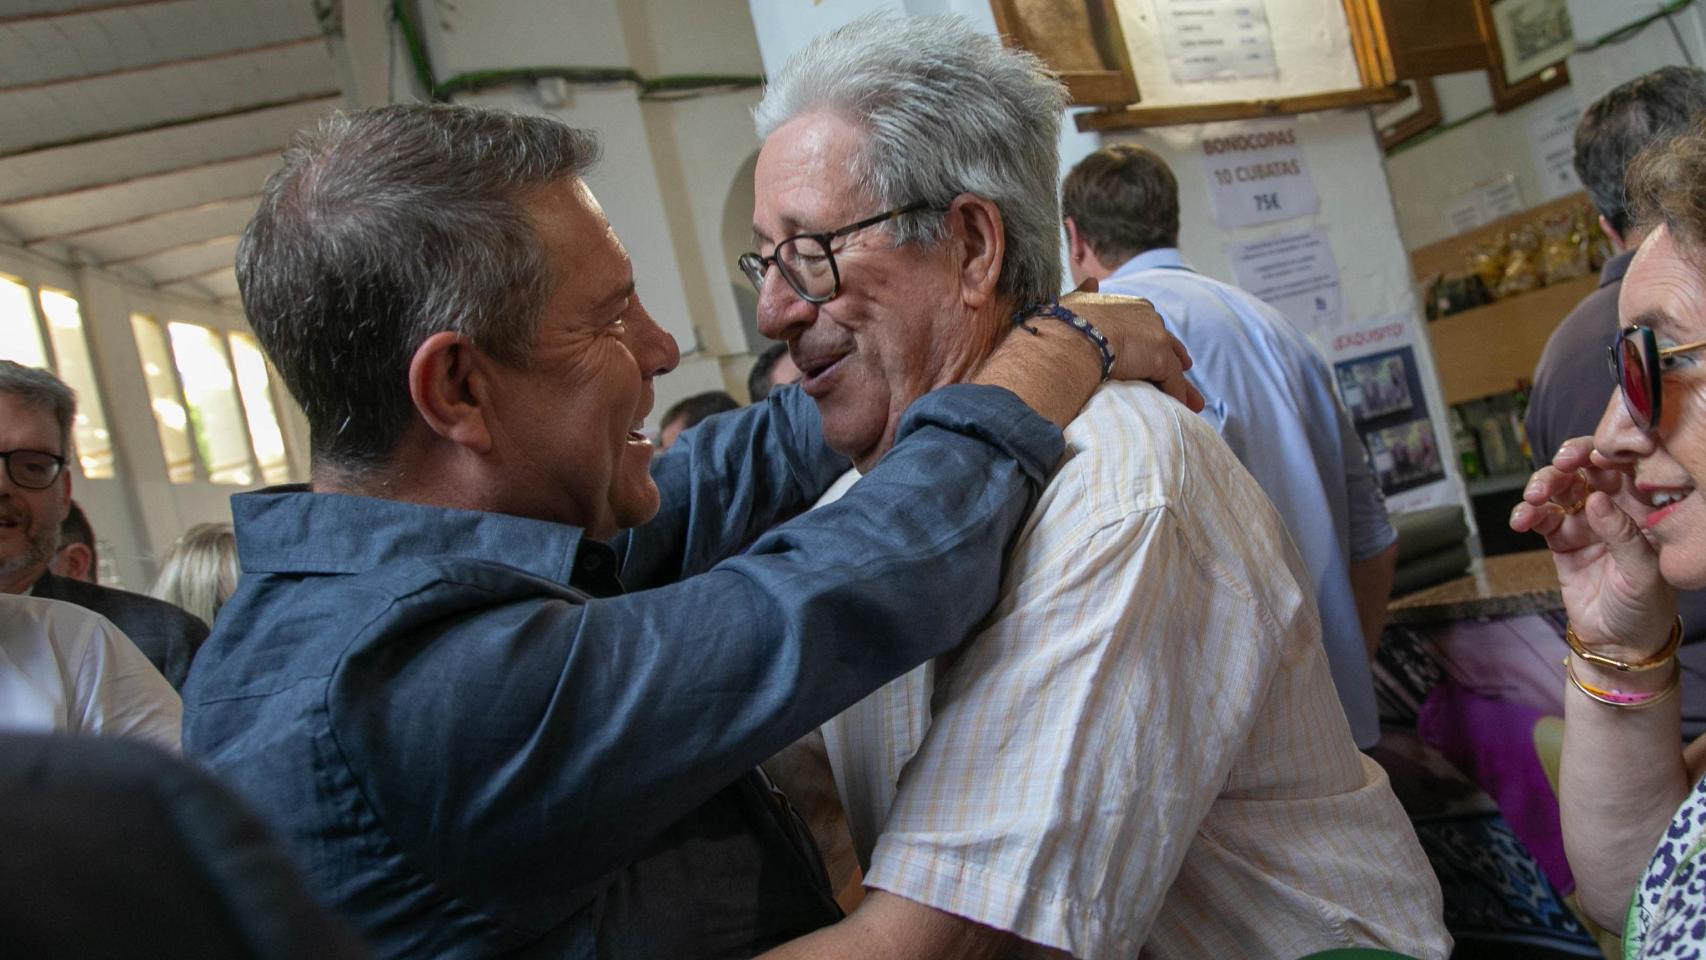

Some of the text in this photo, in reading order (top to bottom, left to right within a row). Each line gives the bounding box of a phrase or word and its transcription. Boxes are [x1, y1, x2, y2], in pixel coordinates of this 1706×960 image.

[1203, 129, 1296, 155] BONOCOPAS
[1213, 159, 1301, 186] 10 CUBATAS
[1252, 192, 1282, 211] 75€
